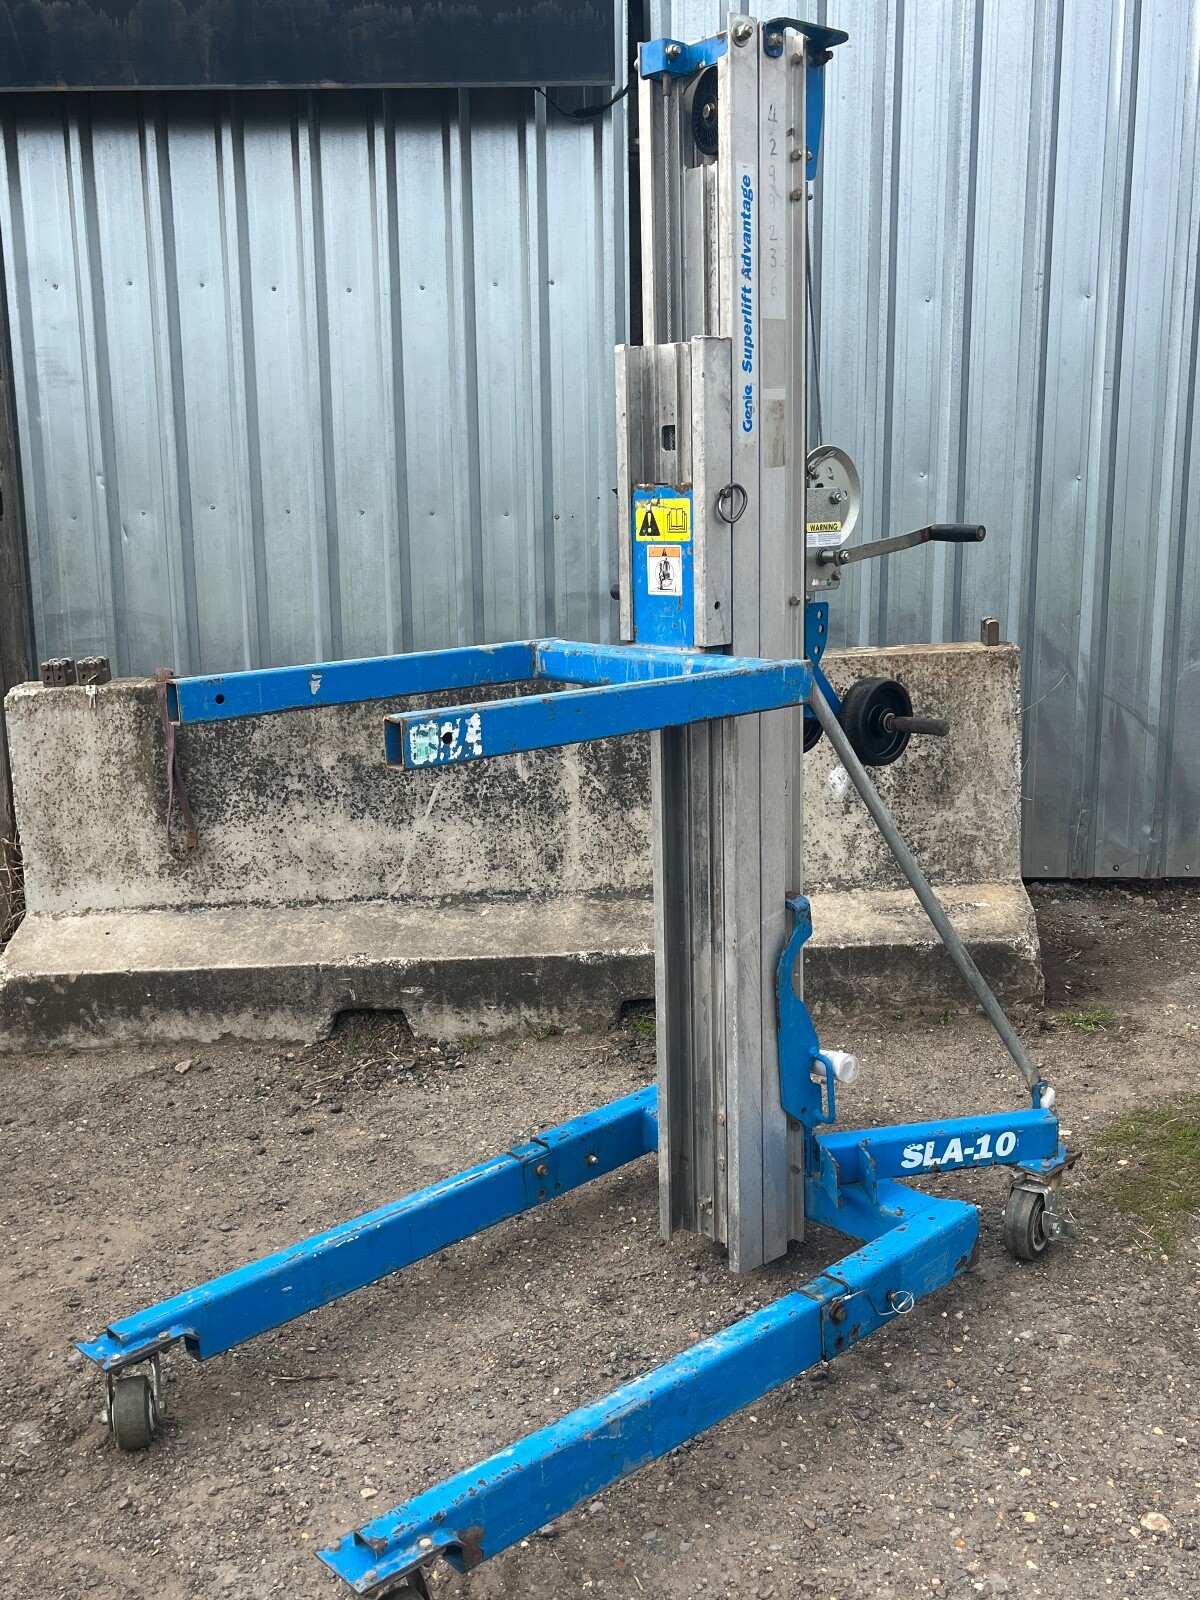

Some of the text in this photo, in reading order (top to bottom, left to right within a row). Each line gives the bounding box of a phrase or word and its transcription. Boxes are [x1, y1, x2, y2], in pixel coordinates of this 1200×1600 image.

[741, 174, 754, 433] Genie Superlift Advantage
[809, 522, 838, 531] WARNING
[901, 1131, 1017, 1169] SLA-10
